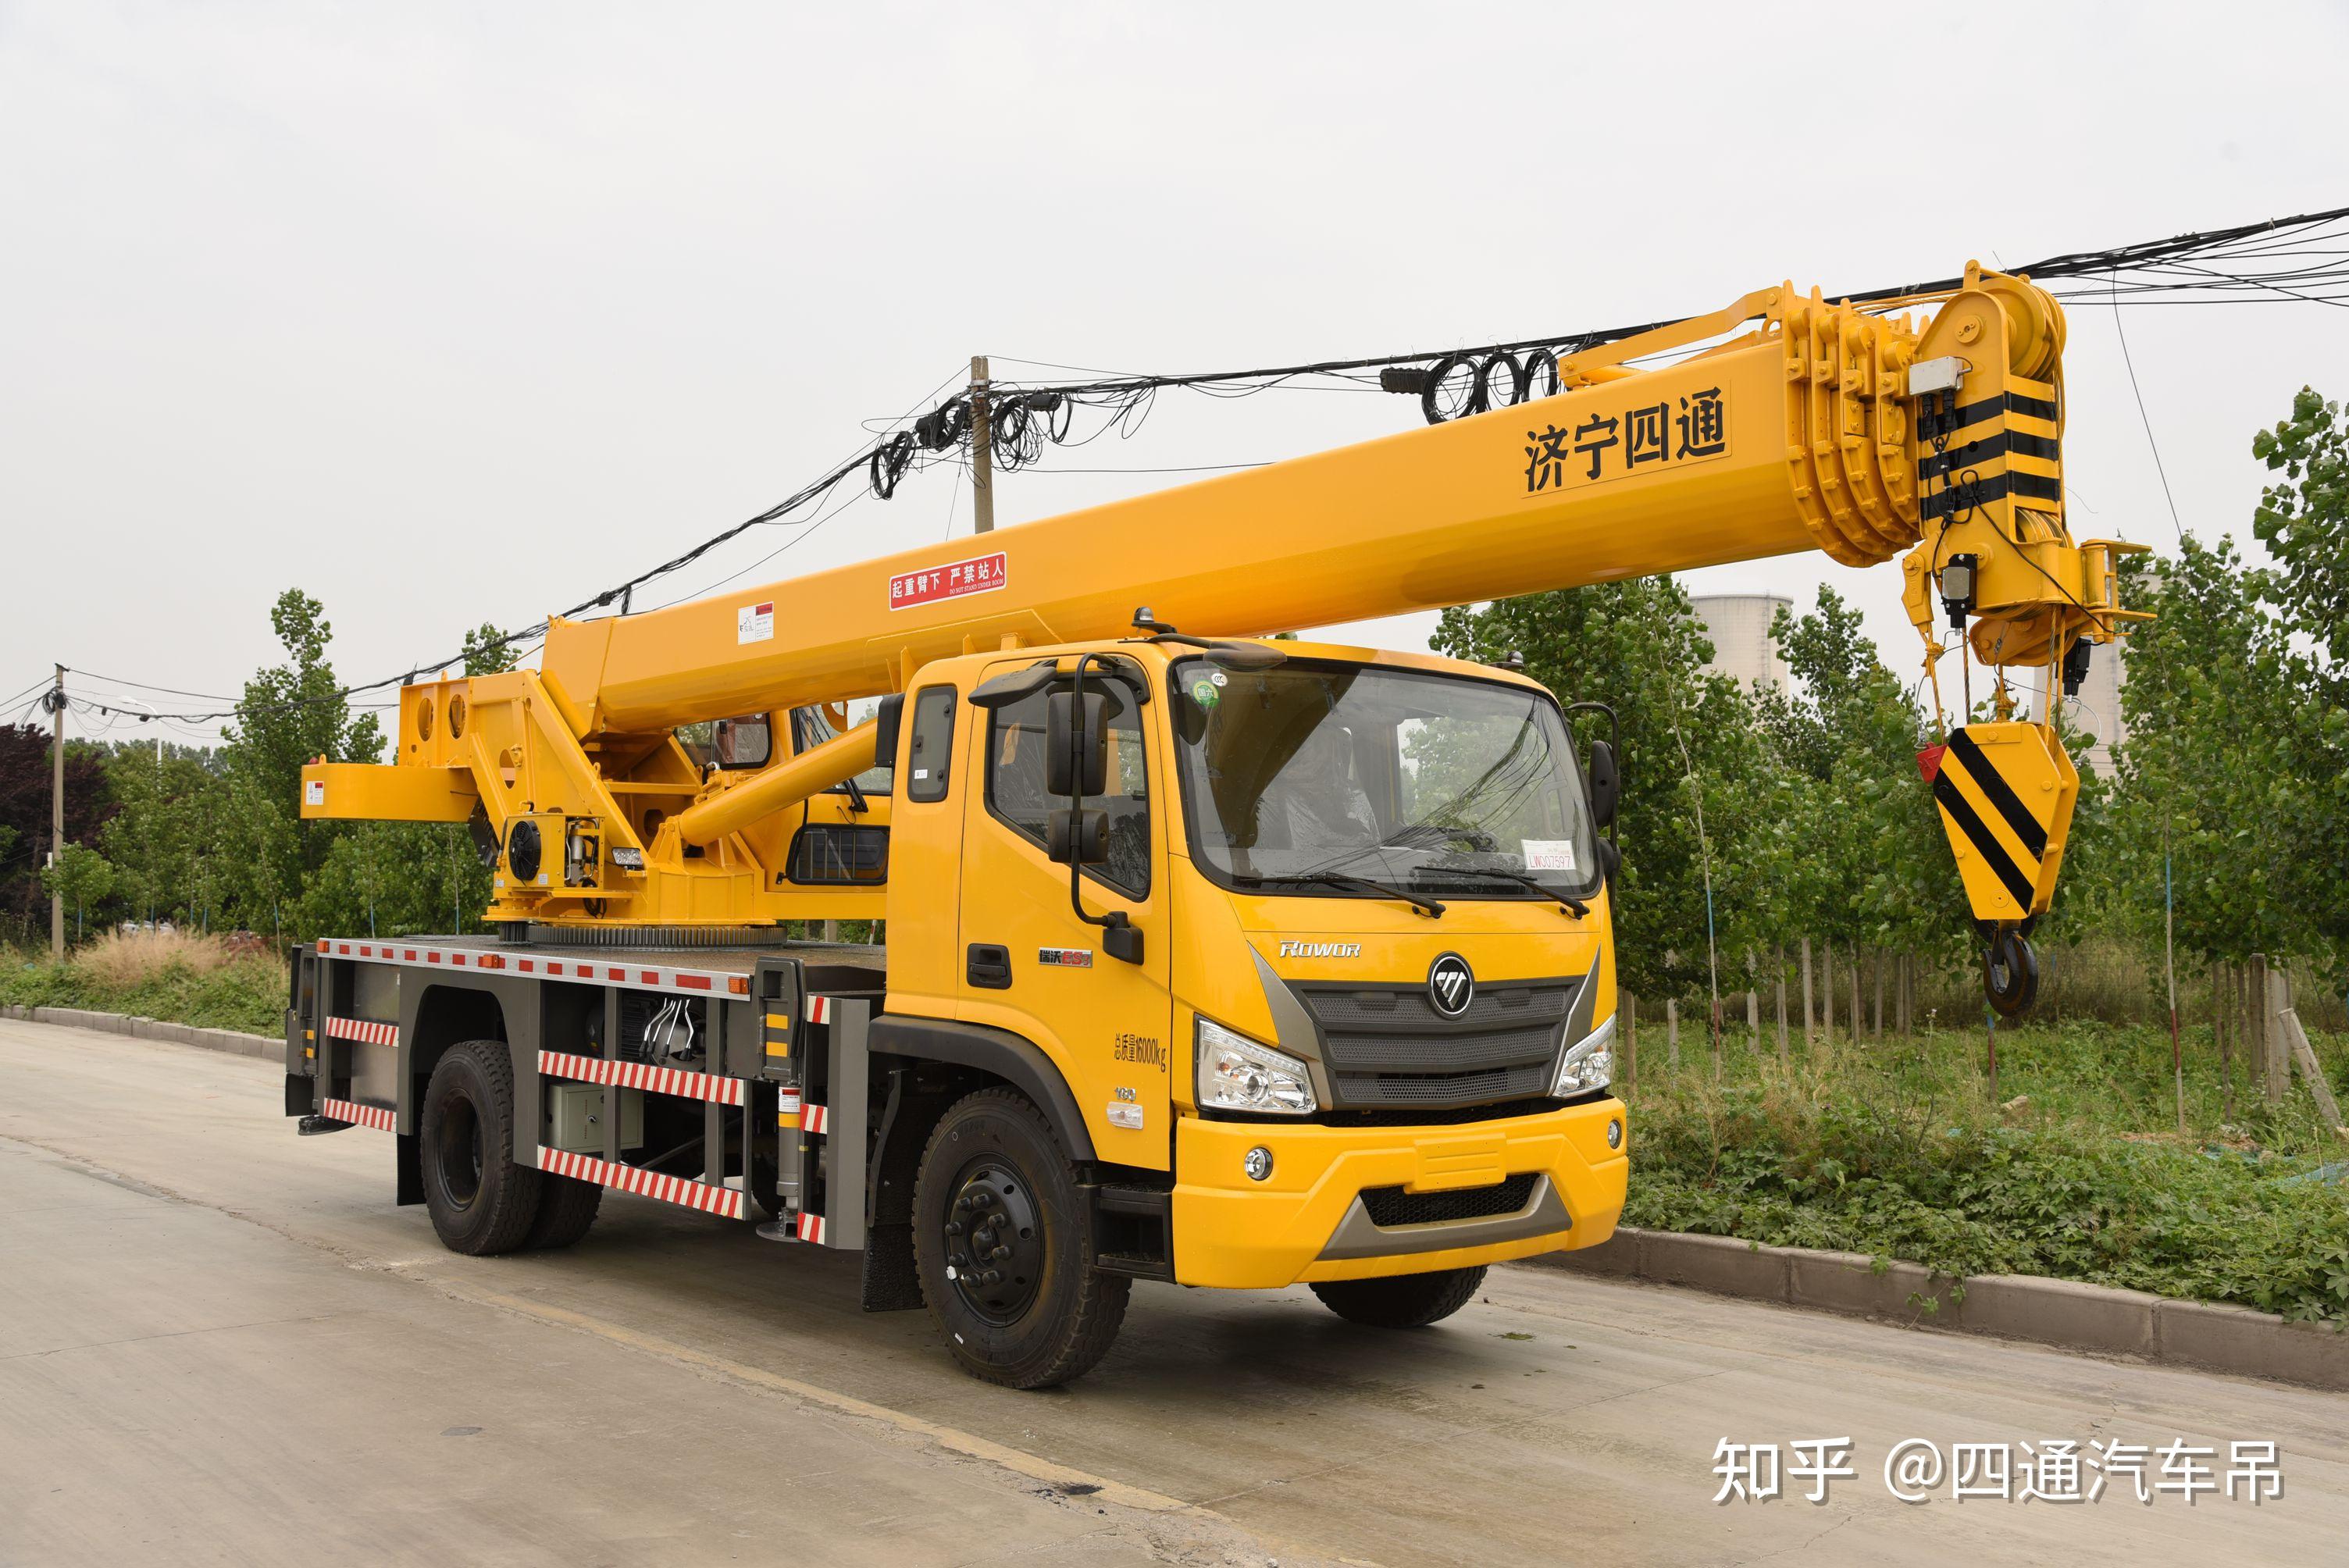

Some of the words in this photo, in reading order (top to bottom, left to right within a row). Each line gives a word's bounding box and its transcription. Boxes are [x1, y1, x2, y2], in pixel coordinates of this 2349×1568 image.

[1524, 387, 1725, 492] 济宁四通
[892, 572, 940, 599] 起重臂下
[950, 558, 1003, 586] 严禁站人
[964, 583, 977, 592] STAND
[1197, 687, 1213, 697] 国六
